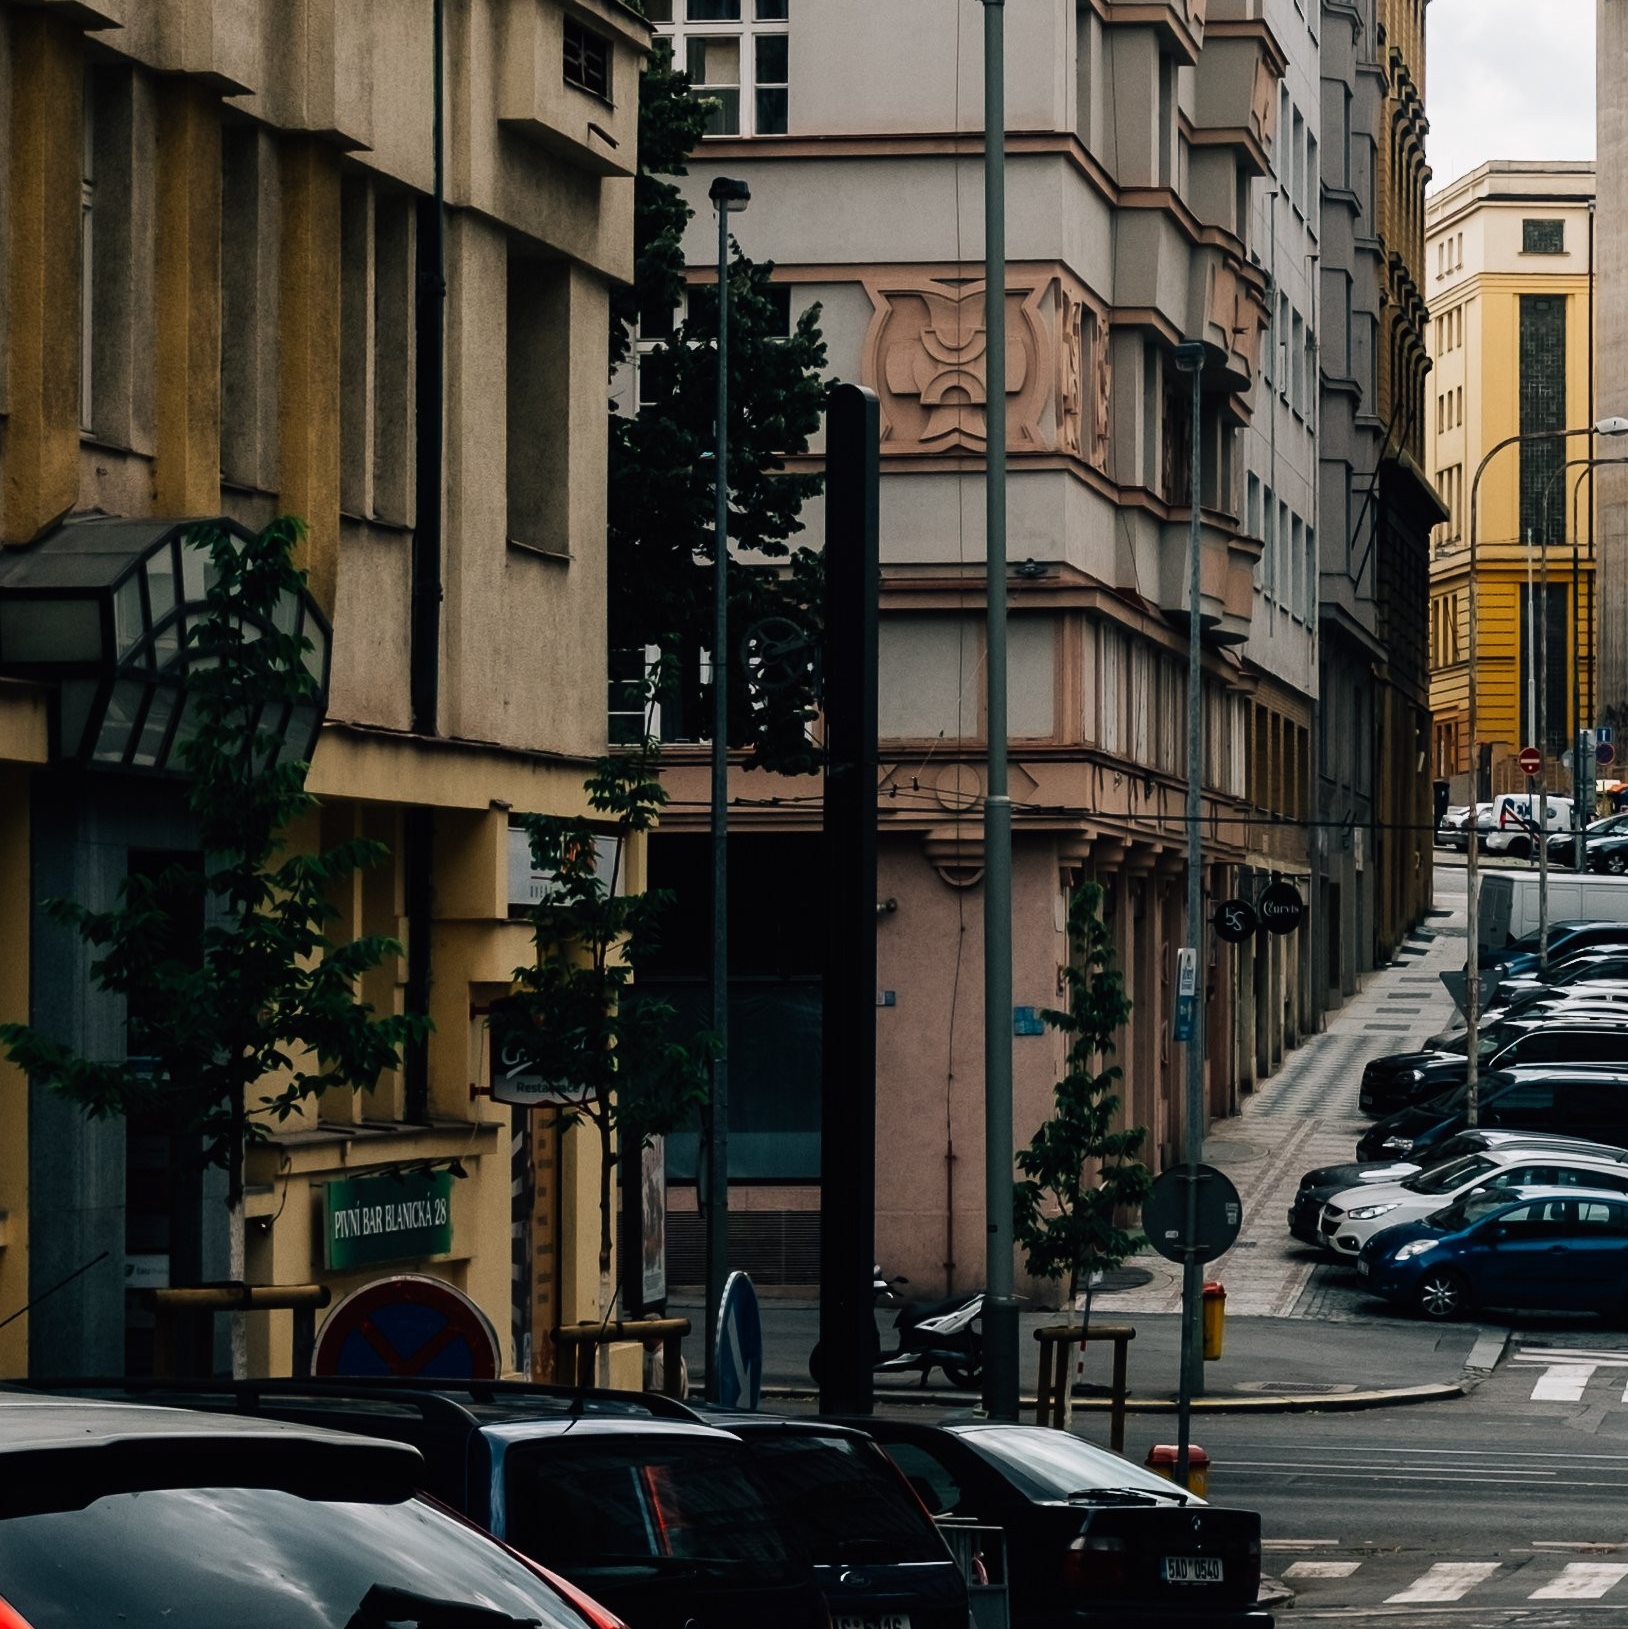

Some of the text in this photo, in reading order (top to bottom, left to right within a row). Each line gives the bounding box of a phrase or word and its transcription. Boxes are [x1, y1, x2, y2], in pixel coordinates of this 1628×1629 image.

[334, 1191, 447, 1239] PIVNÍ BAR BLANICKÁ 28
